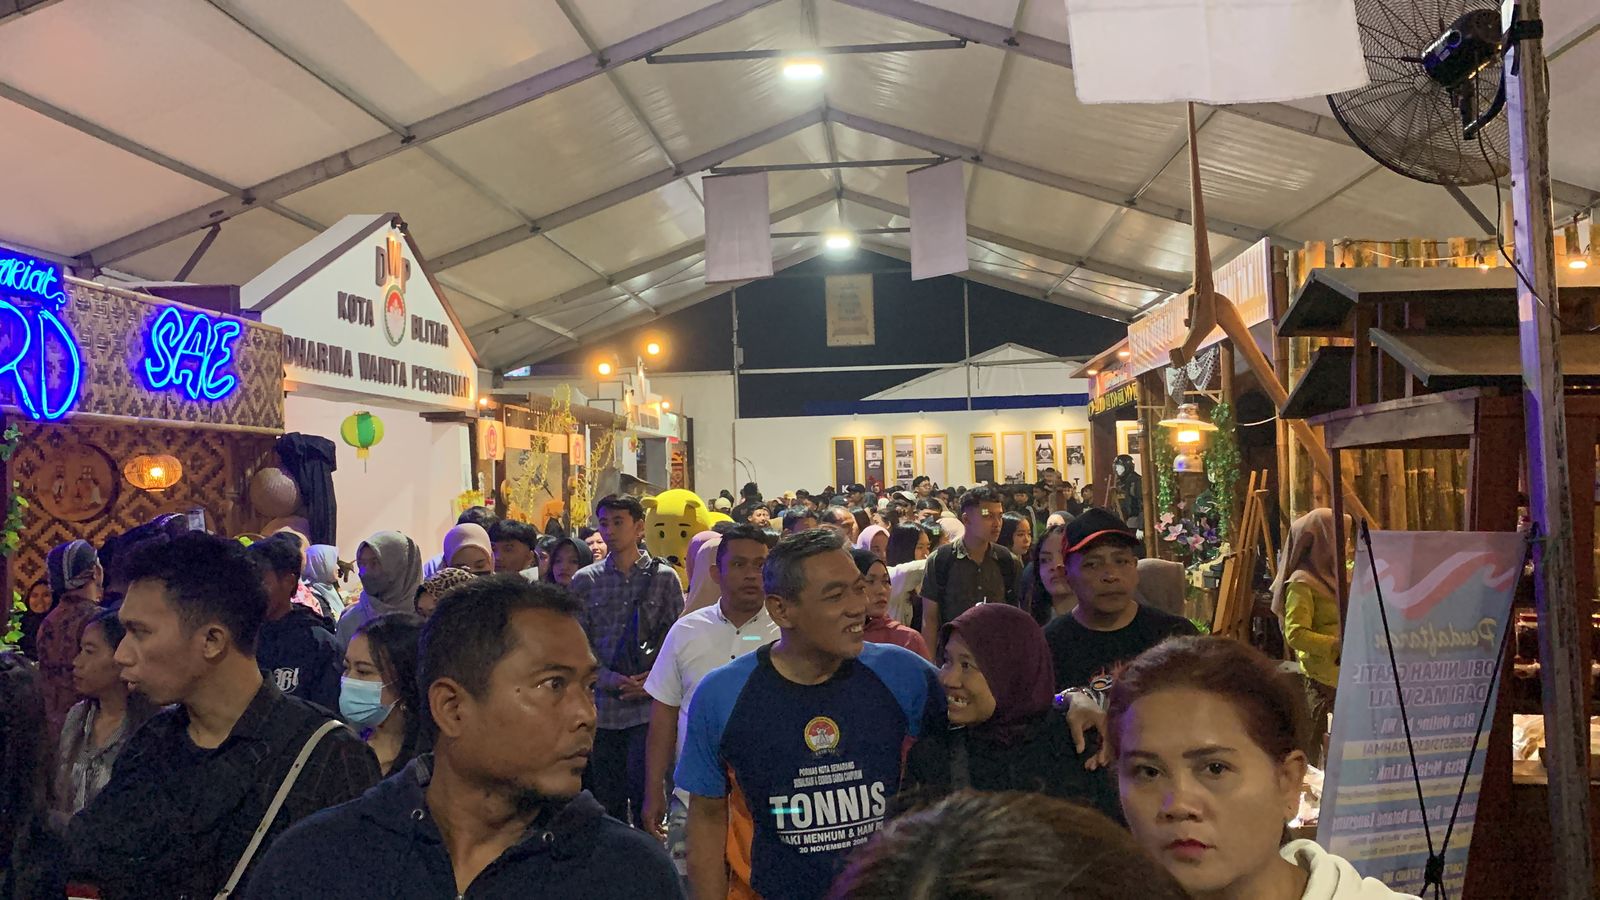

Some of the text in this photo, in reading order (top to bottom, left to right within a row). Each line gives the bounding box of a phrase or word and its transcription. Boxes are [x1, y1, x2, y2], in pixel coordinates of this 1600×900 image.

[337, 291, 449, 348] KOTA BLITAR
[283, 334, 353, 378] DHARMA
[358, 352, 407, 387] WANITA
[769, 781, 886, 829] TONNIS
[804, 830, 846, 844] MENHUM
[848, 828, 855, 838] &
[857, 823, 874, 836] HAM
[810, 841, 852, 853] NOVEMBER
